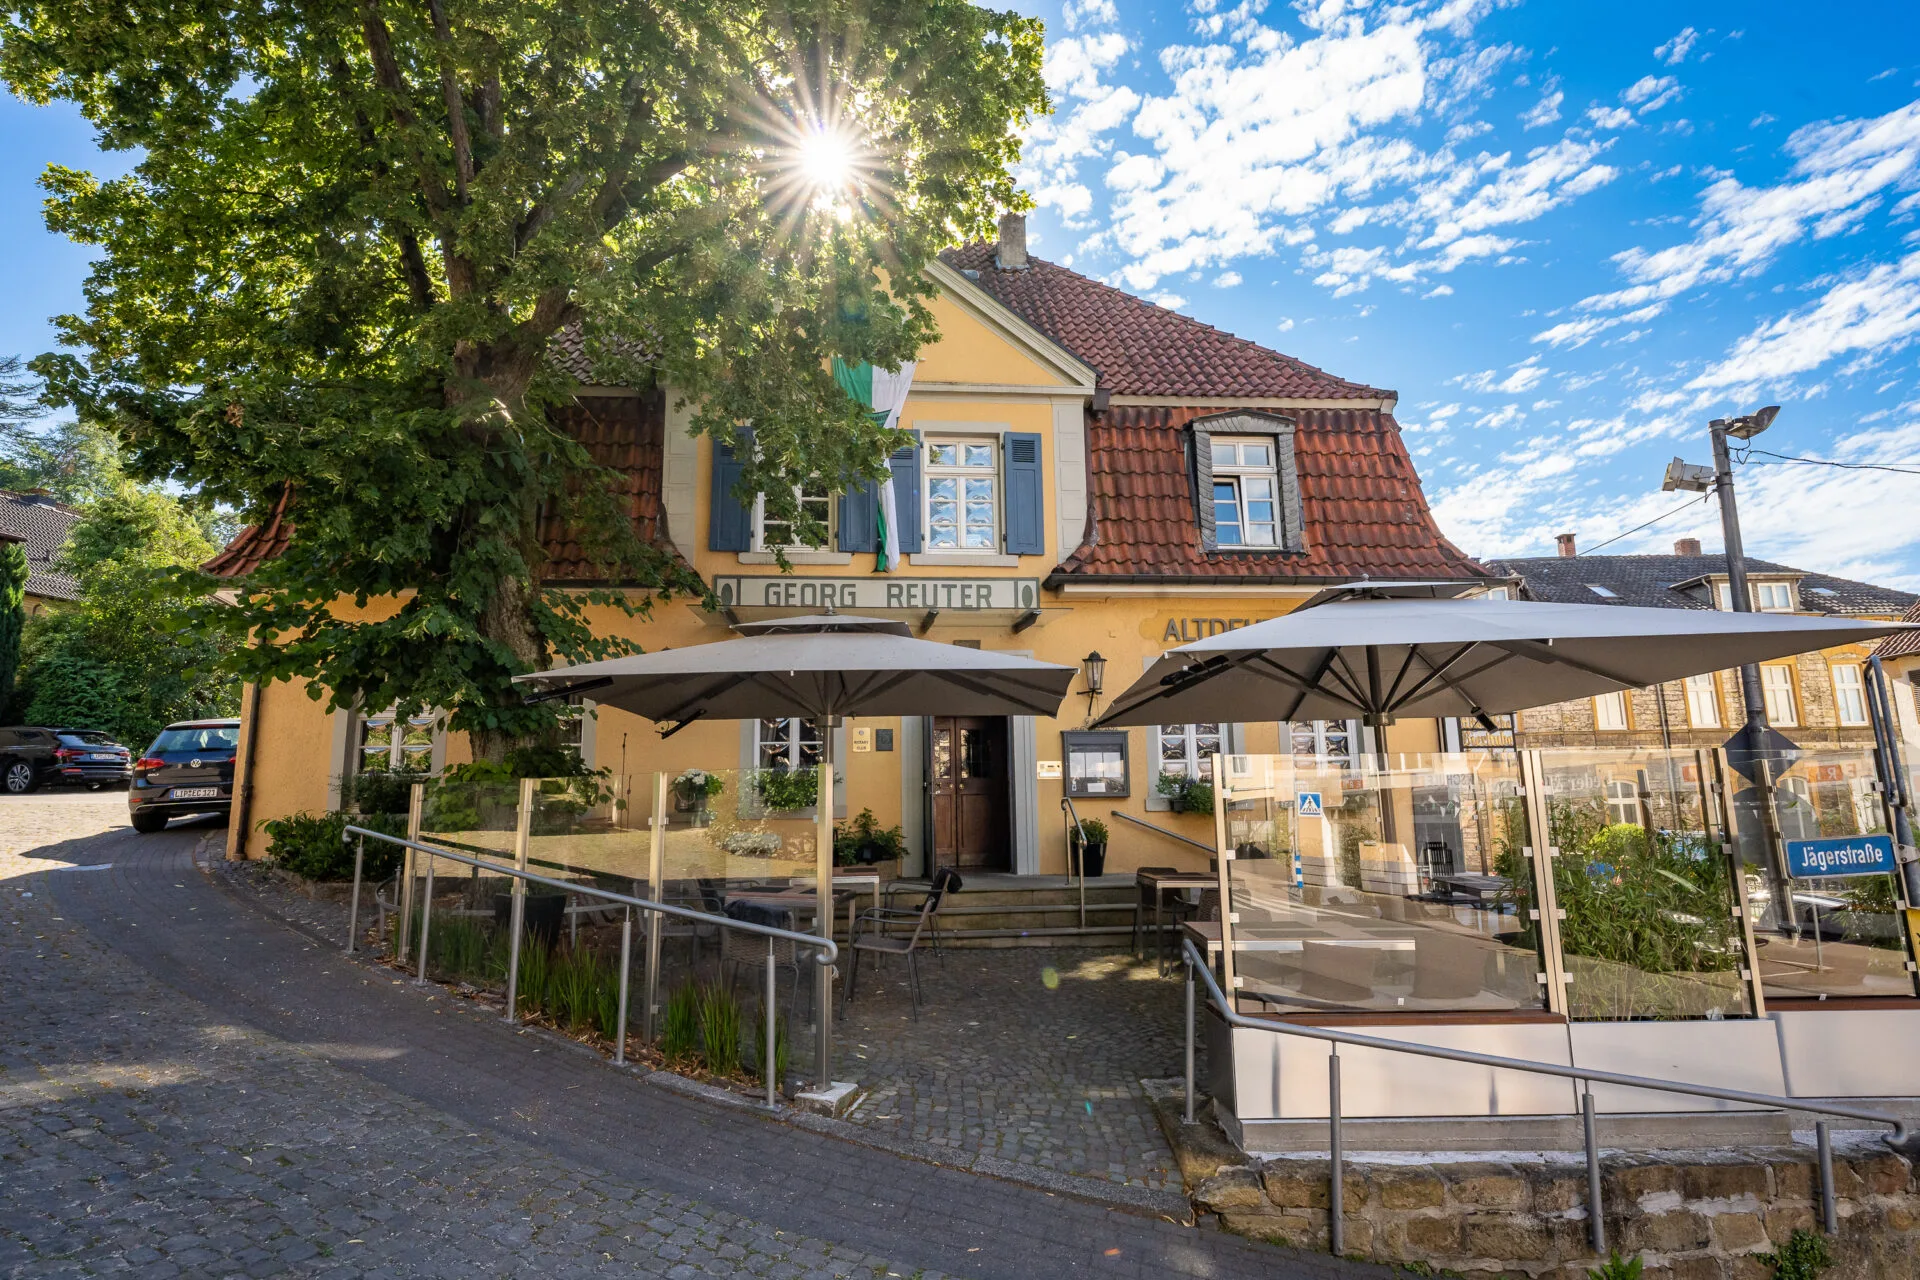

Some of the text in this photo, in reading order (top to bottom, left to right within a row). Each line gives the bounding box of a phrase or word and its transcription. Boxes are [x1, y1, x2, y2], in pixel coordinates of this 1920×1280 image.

[764, 583, 993, 609] GEORG REUTER
[1801, 843, 1884, 871] Jägerstraße
